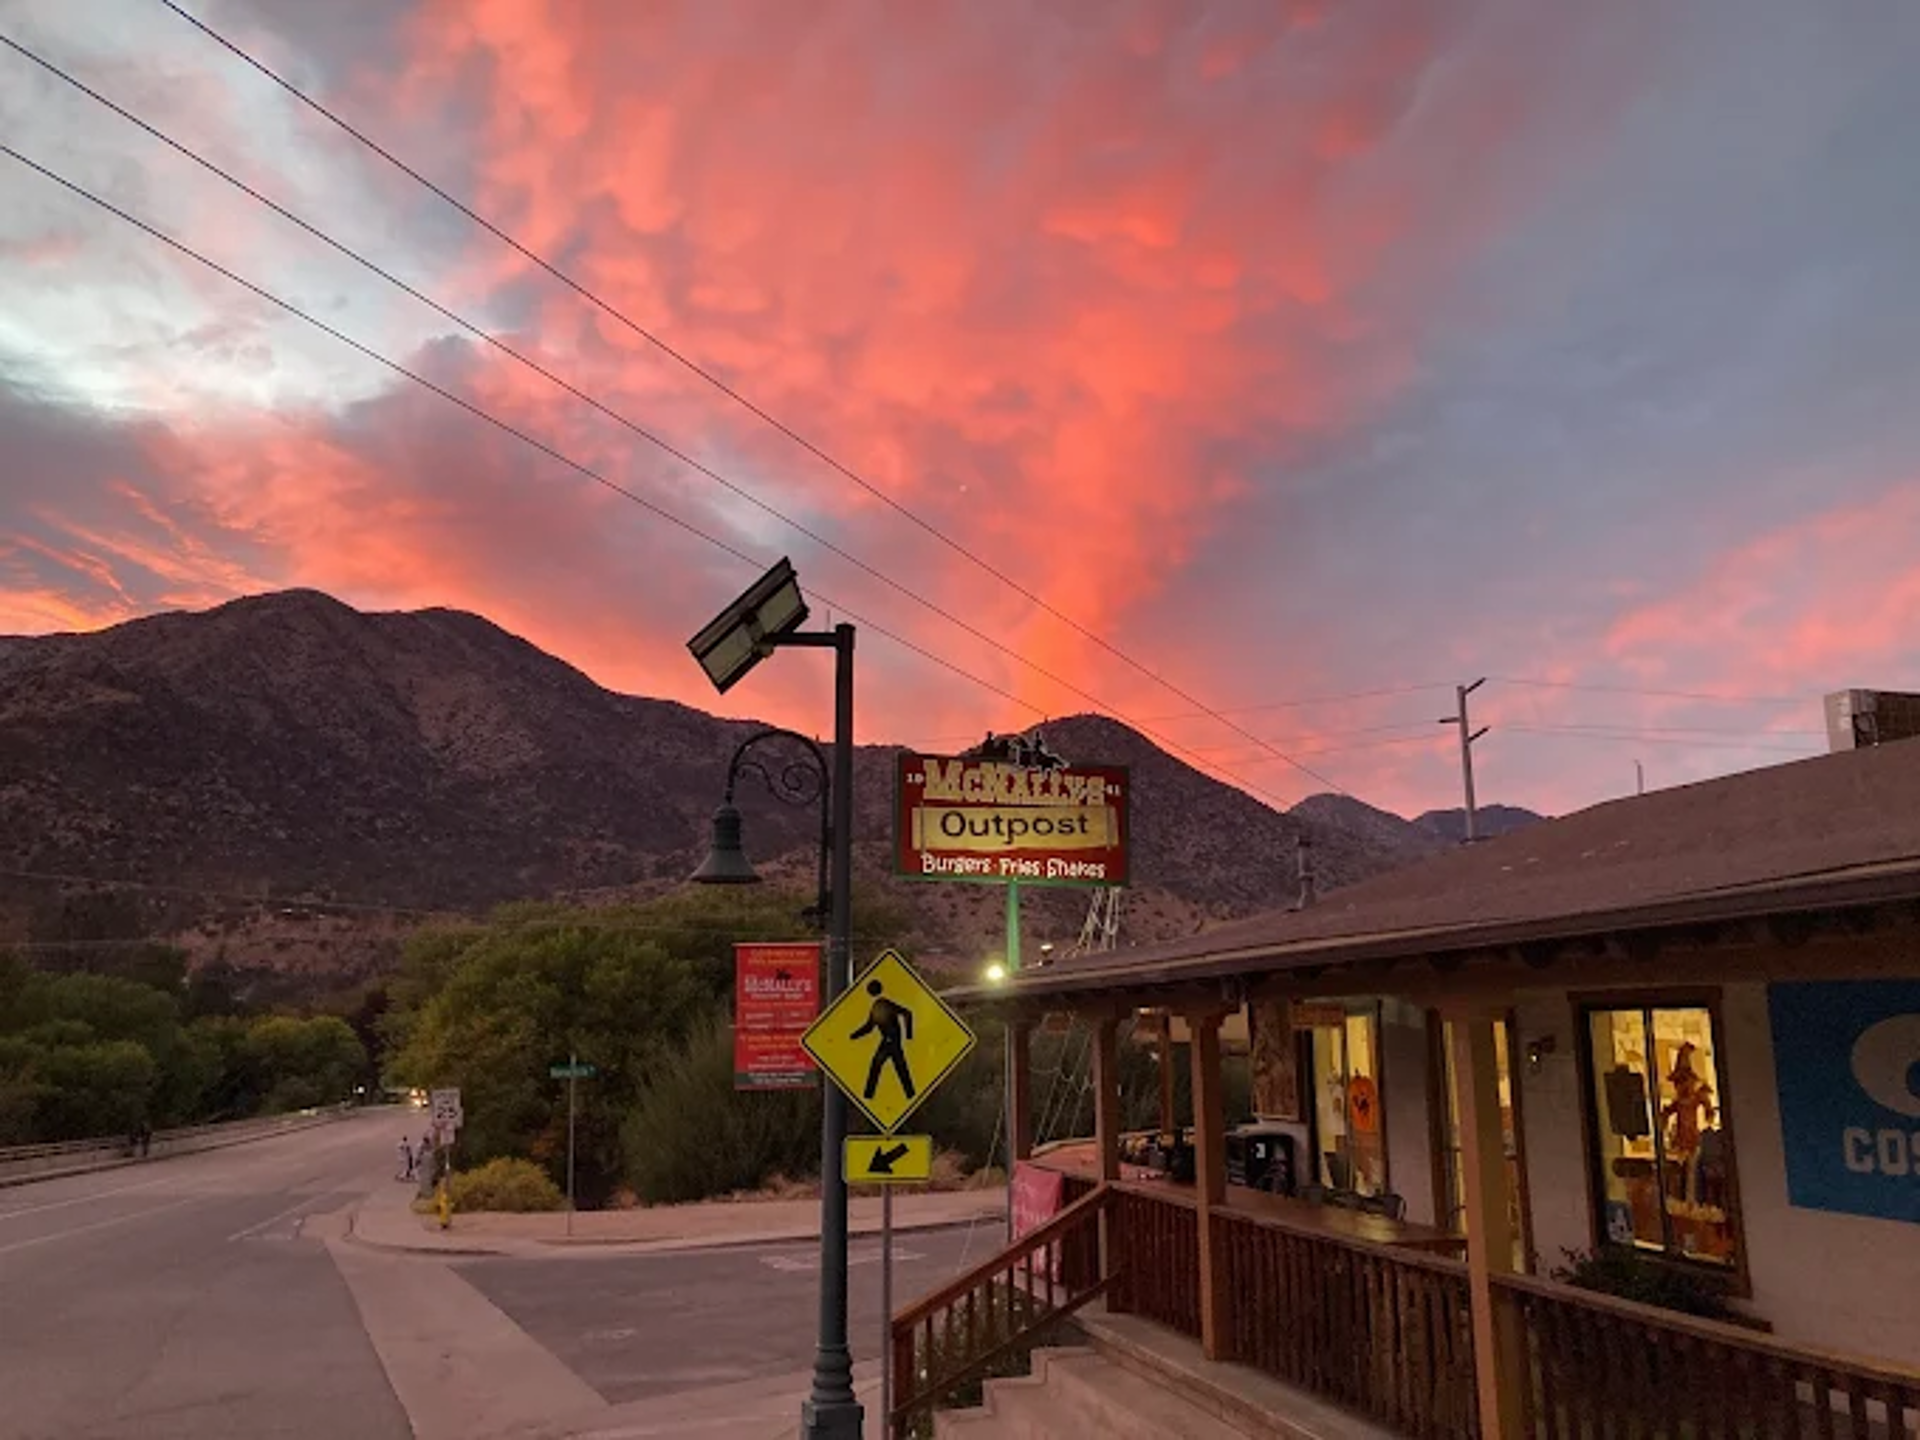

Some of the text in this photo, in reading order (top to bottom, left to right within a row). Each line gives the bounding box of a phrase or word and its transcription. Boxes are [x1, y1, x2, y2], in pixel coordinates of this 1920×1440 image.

[940, 810, 1089, 845] Outpost
[921, 853, 1106, 879] Burgers Fries Shakes
